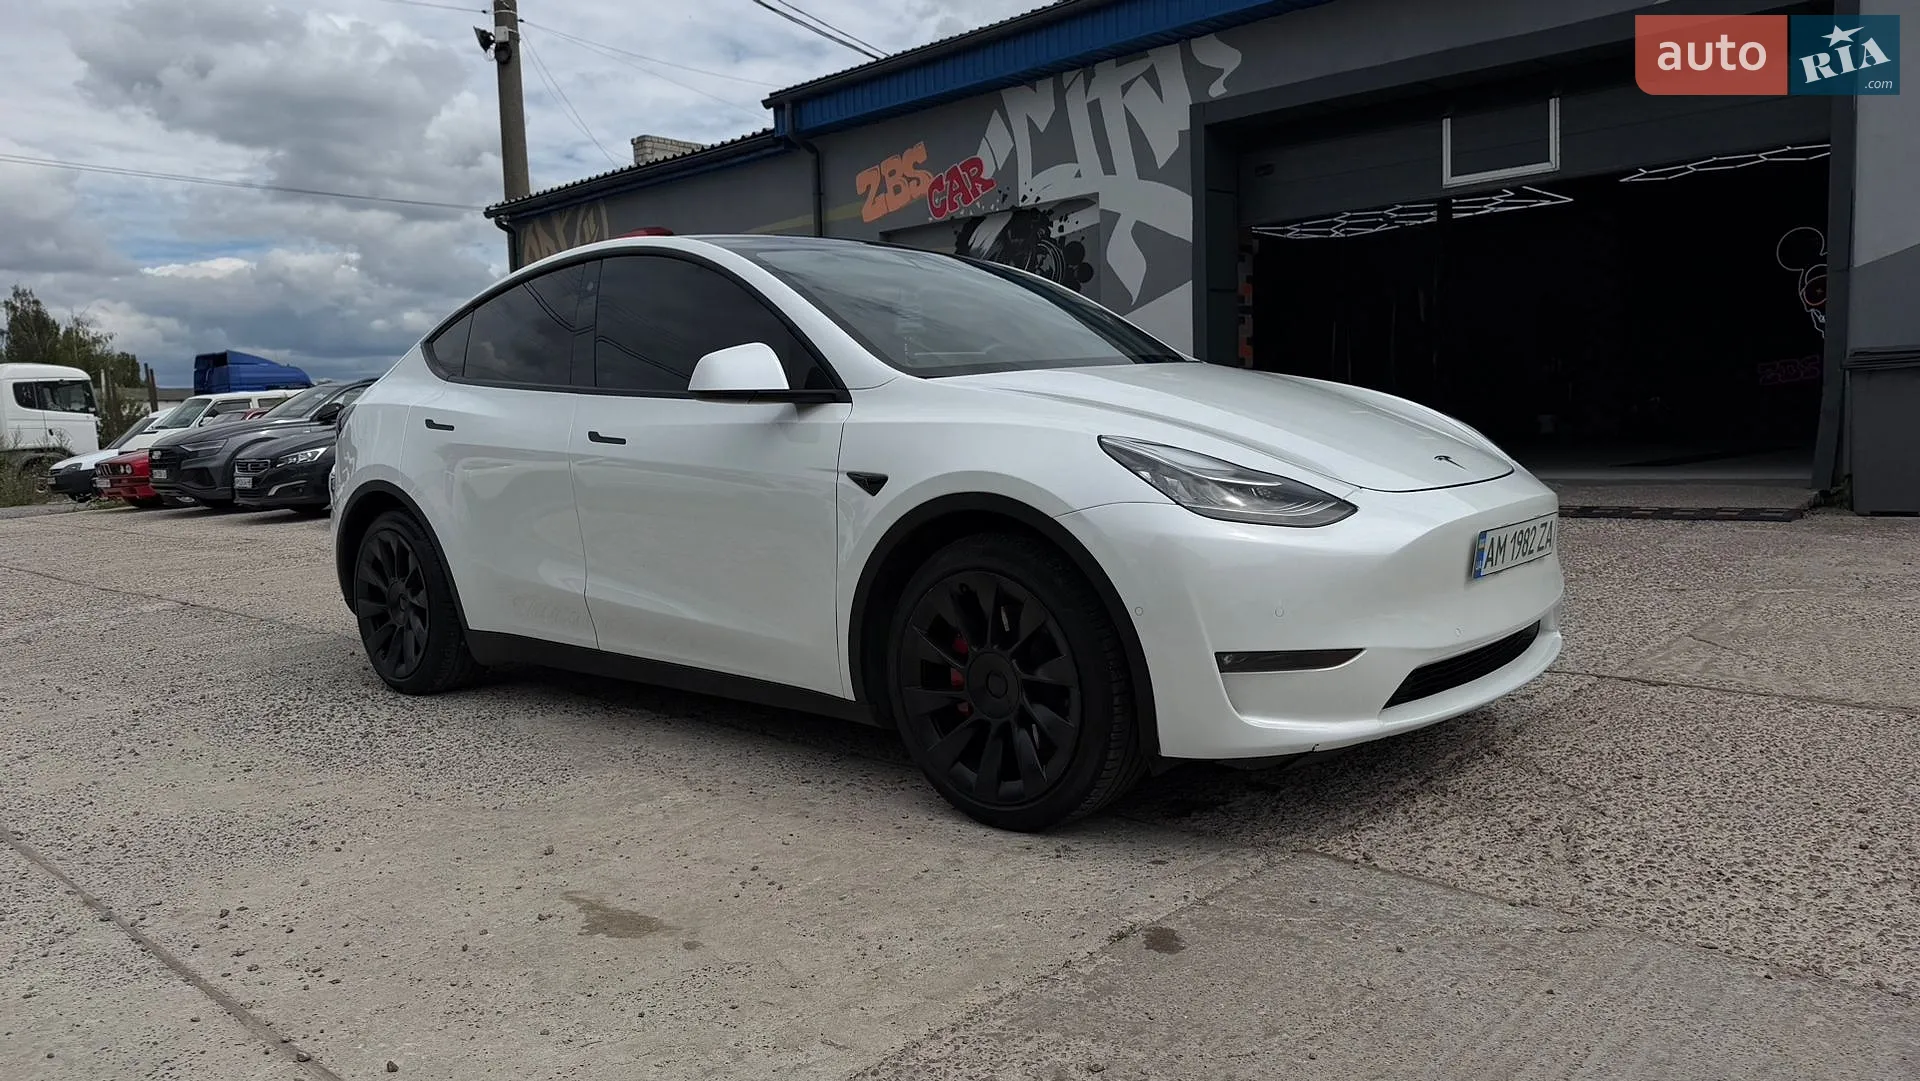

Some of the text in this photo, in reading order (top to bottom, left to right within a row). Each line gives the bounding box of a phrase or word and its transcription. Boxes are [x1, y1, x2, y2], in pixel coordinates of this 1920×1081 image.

[856, 141, 997, 223] ZBS CAR
[1484, 521, 1553, 569] AM 1982 ZA
